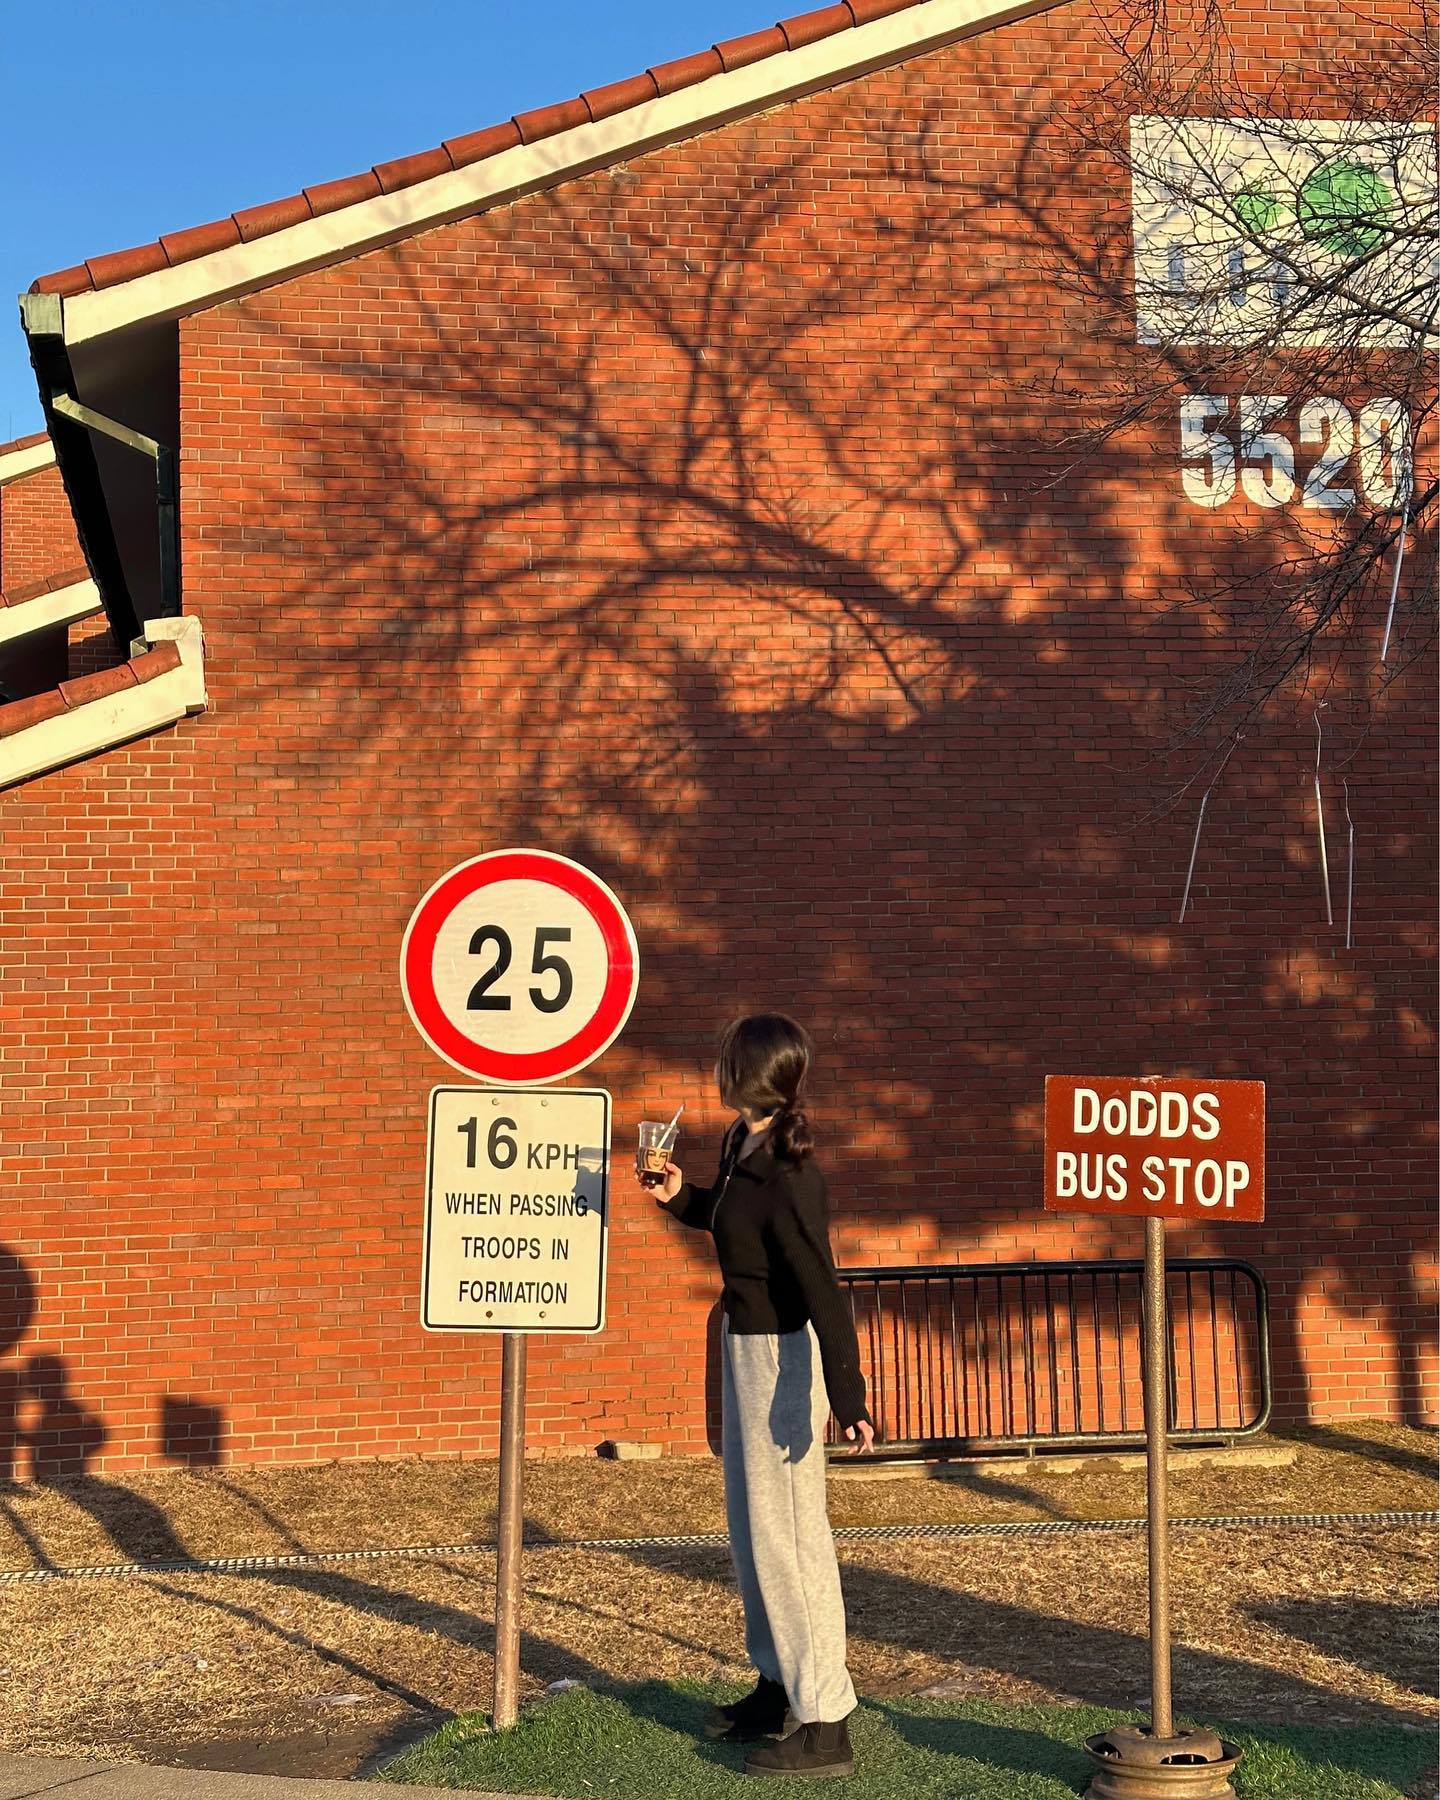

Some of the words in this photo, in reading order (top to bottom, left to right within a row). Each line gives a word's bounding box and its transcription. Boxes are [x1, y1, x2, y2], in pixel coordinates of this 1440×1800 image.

[1180, 396, 1414, 509] 5520
[466, 924, 573, 1013] 25
[1073, 1088, 1220, 1140] DoDDS
[457, 1116, 518, 1170] 16
[527, 1143, 579, 1170] KPH
[445, 1192, 501, 1215] WHEN
[509, 1194, 588, 1217] PASSING
[1056, 1151, 1128, 1201] BUS
[1142, 1156, 1250, 1208] STOP
[461, 1236, 541, 1260] TROOPS
[551, 1239, 569, 1260] IN
[458, 1280, 567, 1304] FORMATION
